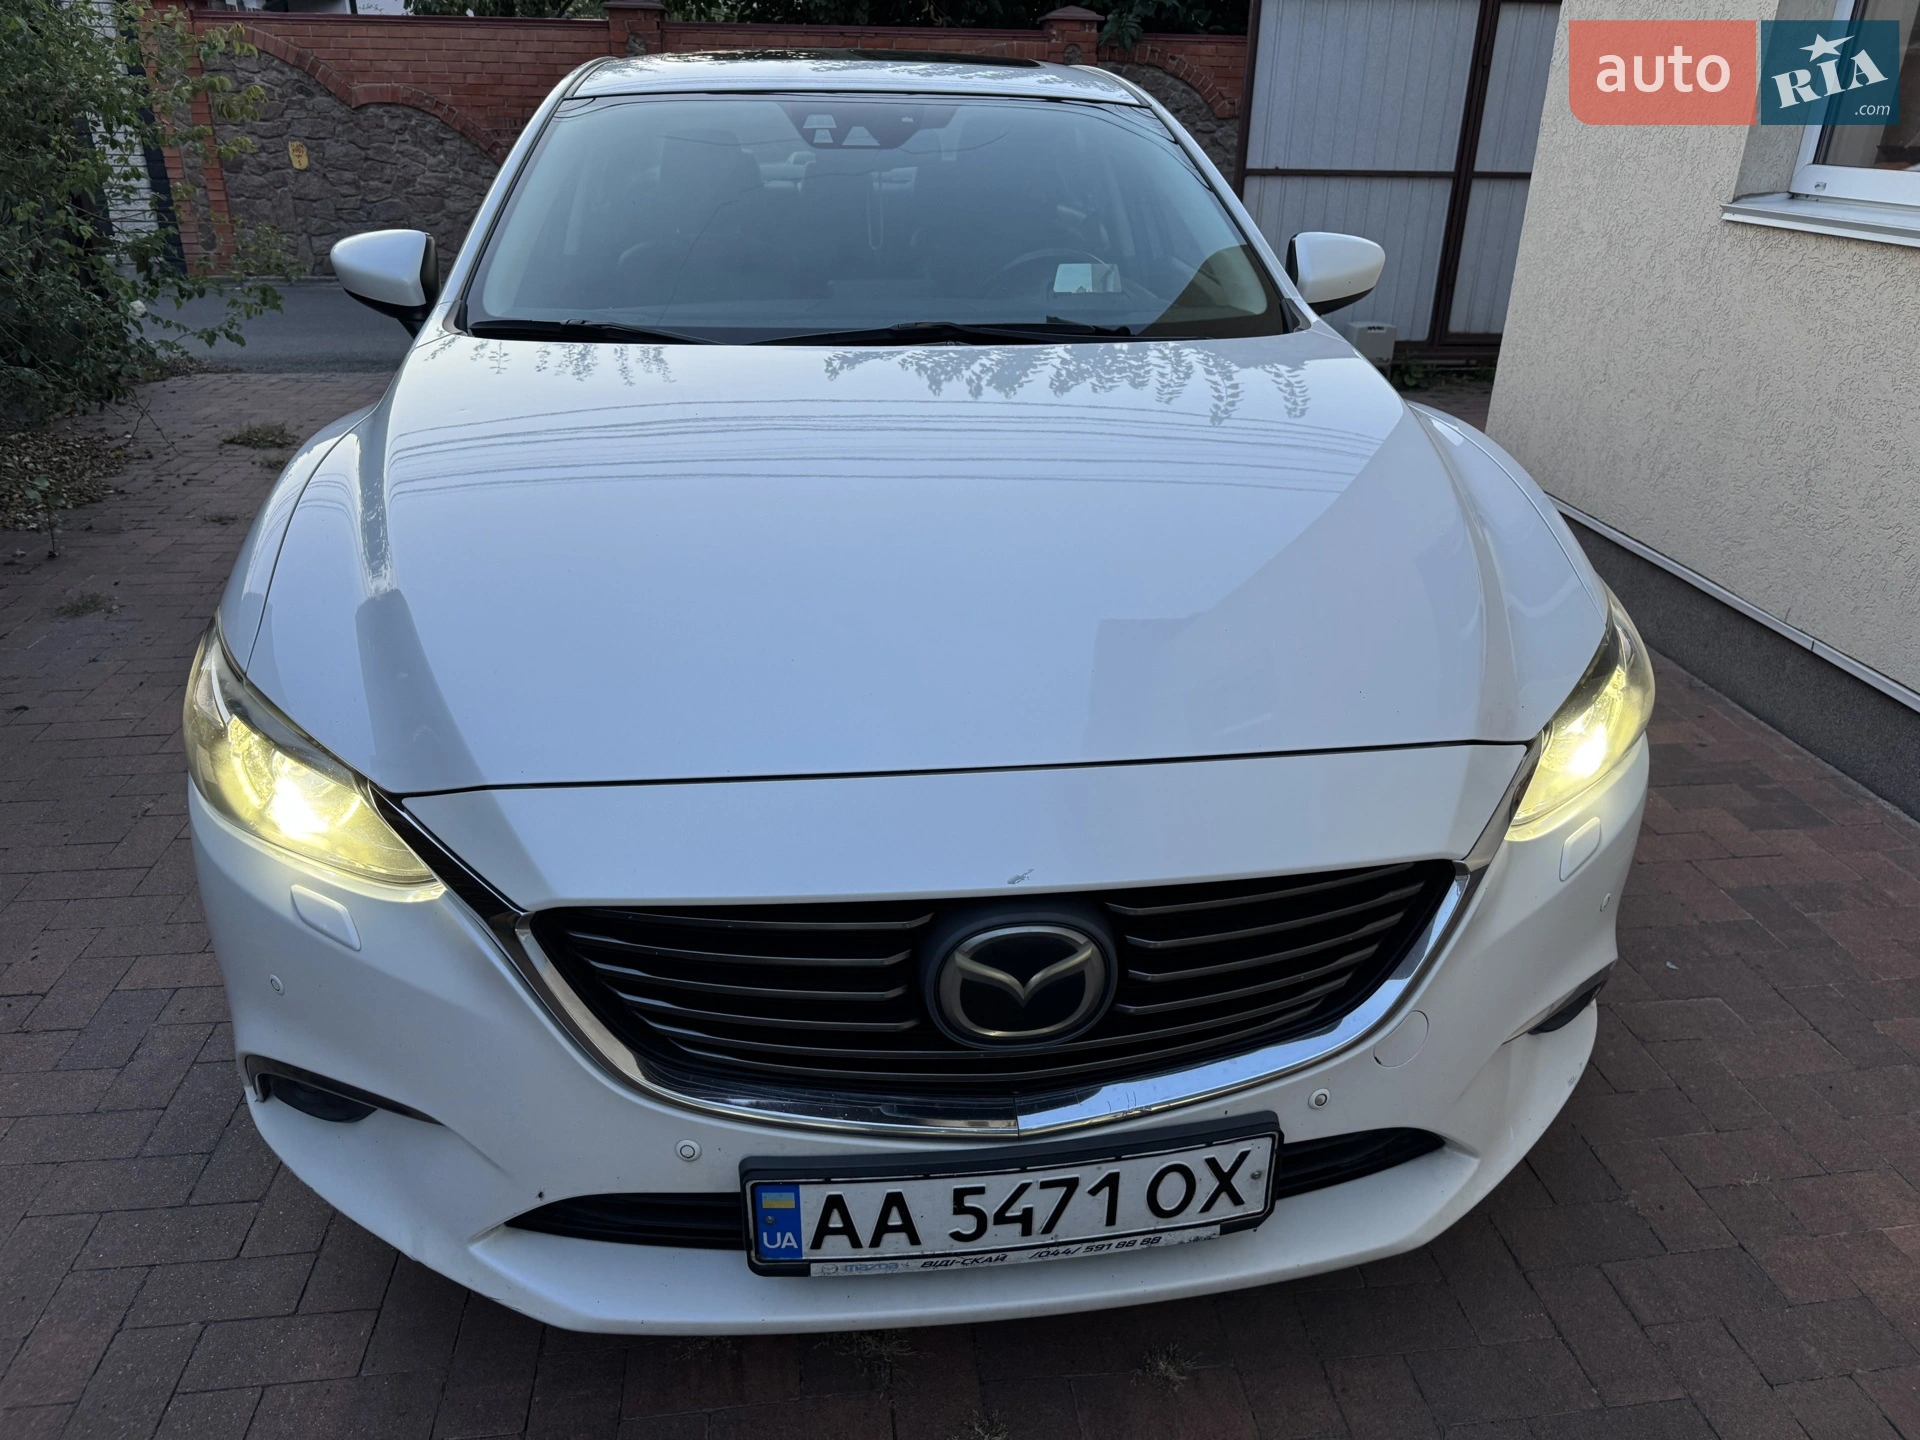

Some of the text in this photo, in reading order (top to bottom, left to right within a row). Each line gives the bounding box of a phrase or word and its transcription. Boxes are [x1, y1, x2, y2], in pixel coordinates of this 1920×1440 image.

[810, 1150, 1252, 1250] AA 5471 OX
[763, 1231, 798, 1249] UA
[1082, 1243, 1113, 1254] 591
[1114, 1239, 1138, 1249] 88
[1139, 1236, 1163, 1246] 88
